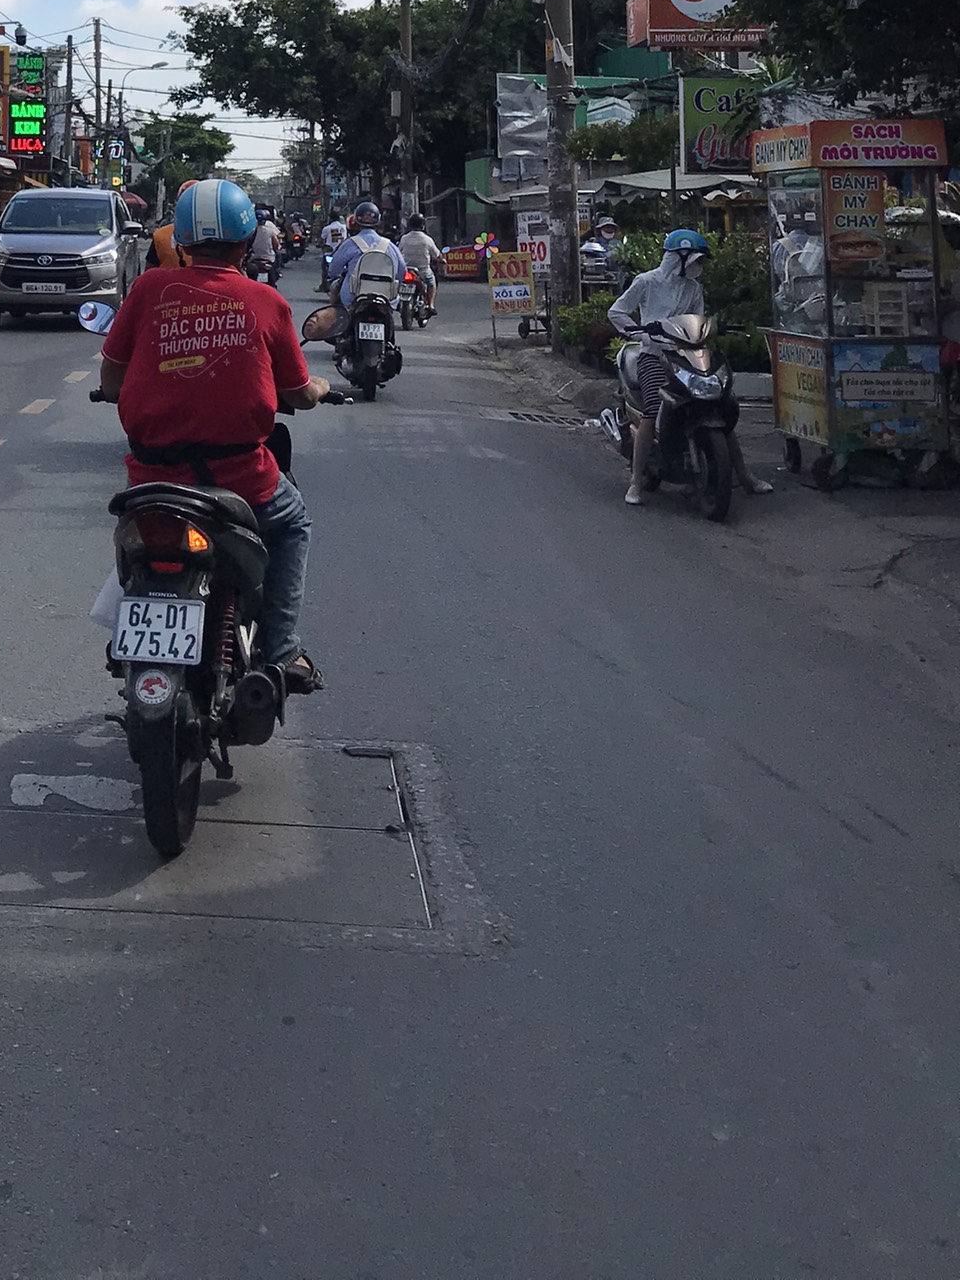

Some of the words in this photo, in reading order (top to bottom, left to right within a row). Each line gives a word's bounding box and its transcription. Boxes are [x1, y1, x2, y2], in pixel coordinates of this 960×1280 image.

[11, 101, 45, 118] BÁNH
[14, 121, 41, 135] KEM
[852, 124, 902, 143] SẠCH
[10, 138, 44, 151] LUCA
[788, 135, 810, 161] CHAY
[820, 143, 859, 161] MÔI
[861, 141, 938, 161] TRƯỜNG
[830, 173, 879, 191] BÁNH
[843, 193, 868, 209] MỲ
[834, 214, 879, 229] CHAY
[491, 255, 530, 279] XÔI
[494, 287, 513, 299] XÔI
[515, 286, 530, 297] GÀ
[161, 306, 180, 319] TÍCH
[182, 302, 204, 315] ĐIỂM
[220, 298, 245, 312] DÀNG
[159, 317, 189, 340] ĐẶC
[194, 310, 246, 334] QUYỀN
[158, 335, 209, 356] THƯỢNG
[212, 333, 247, 350] HẠNG
[128, 603, 188, 630] 64-D1
[117, 630, 196, 659] 475.42
